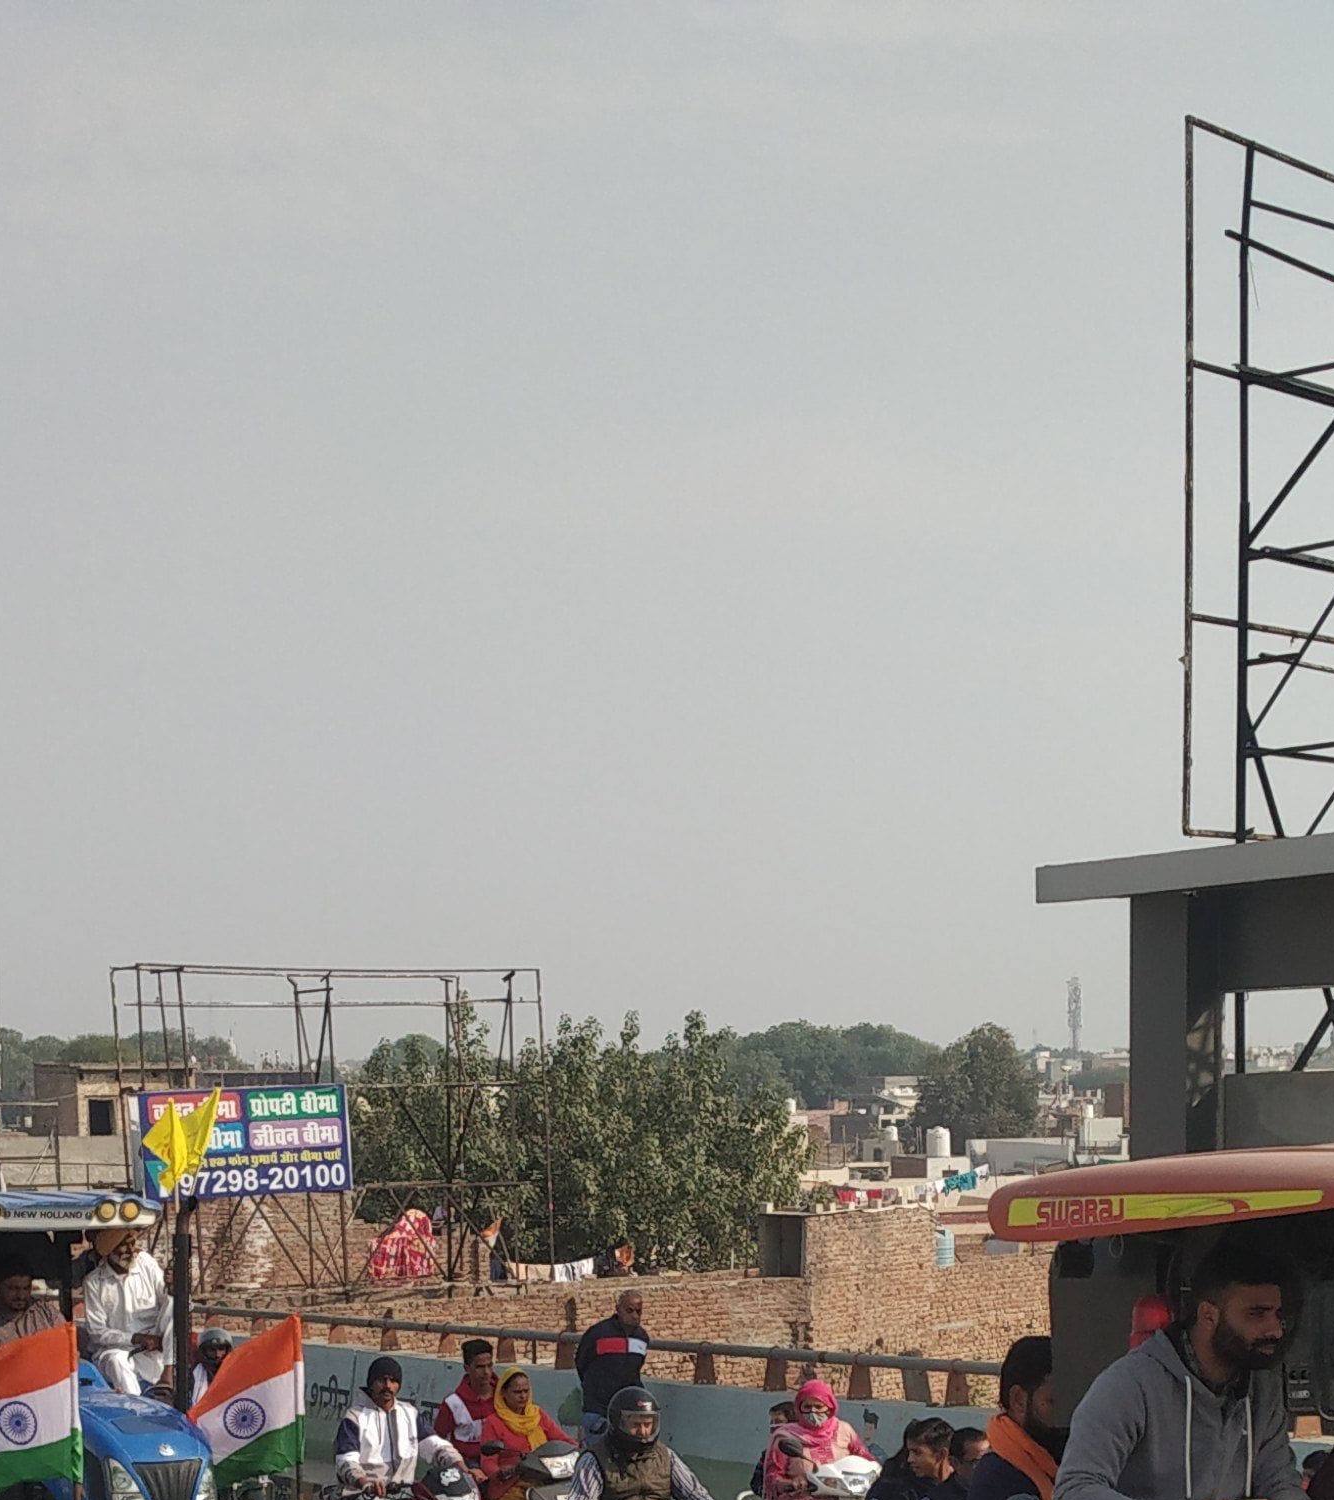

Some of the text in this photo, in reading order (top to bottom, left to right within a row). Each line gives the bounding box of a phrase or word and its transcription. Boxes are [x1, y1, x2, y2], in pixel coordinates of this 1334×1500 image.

[299, 1090, 339, 1114] बीमा
[251, 1121, 340, 1148] जीवन बीमा
[179, 1163, 347, 1196] 97298-20100
[13, 1210, 83, 1219] NEW HOLLAND
